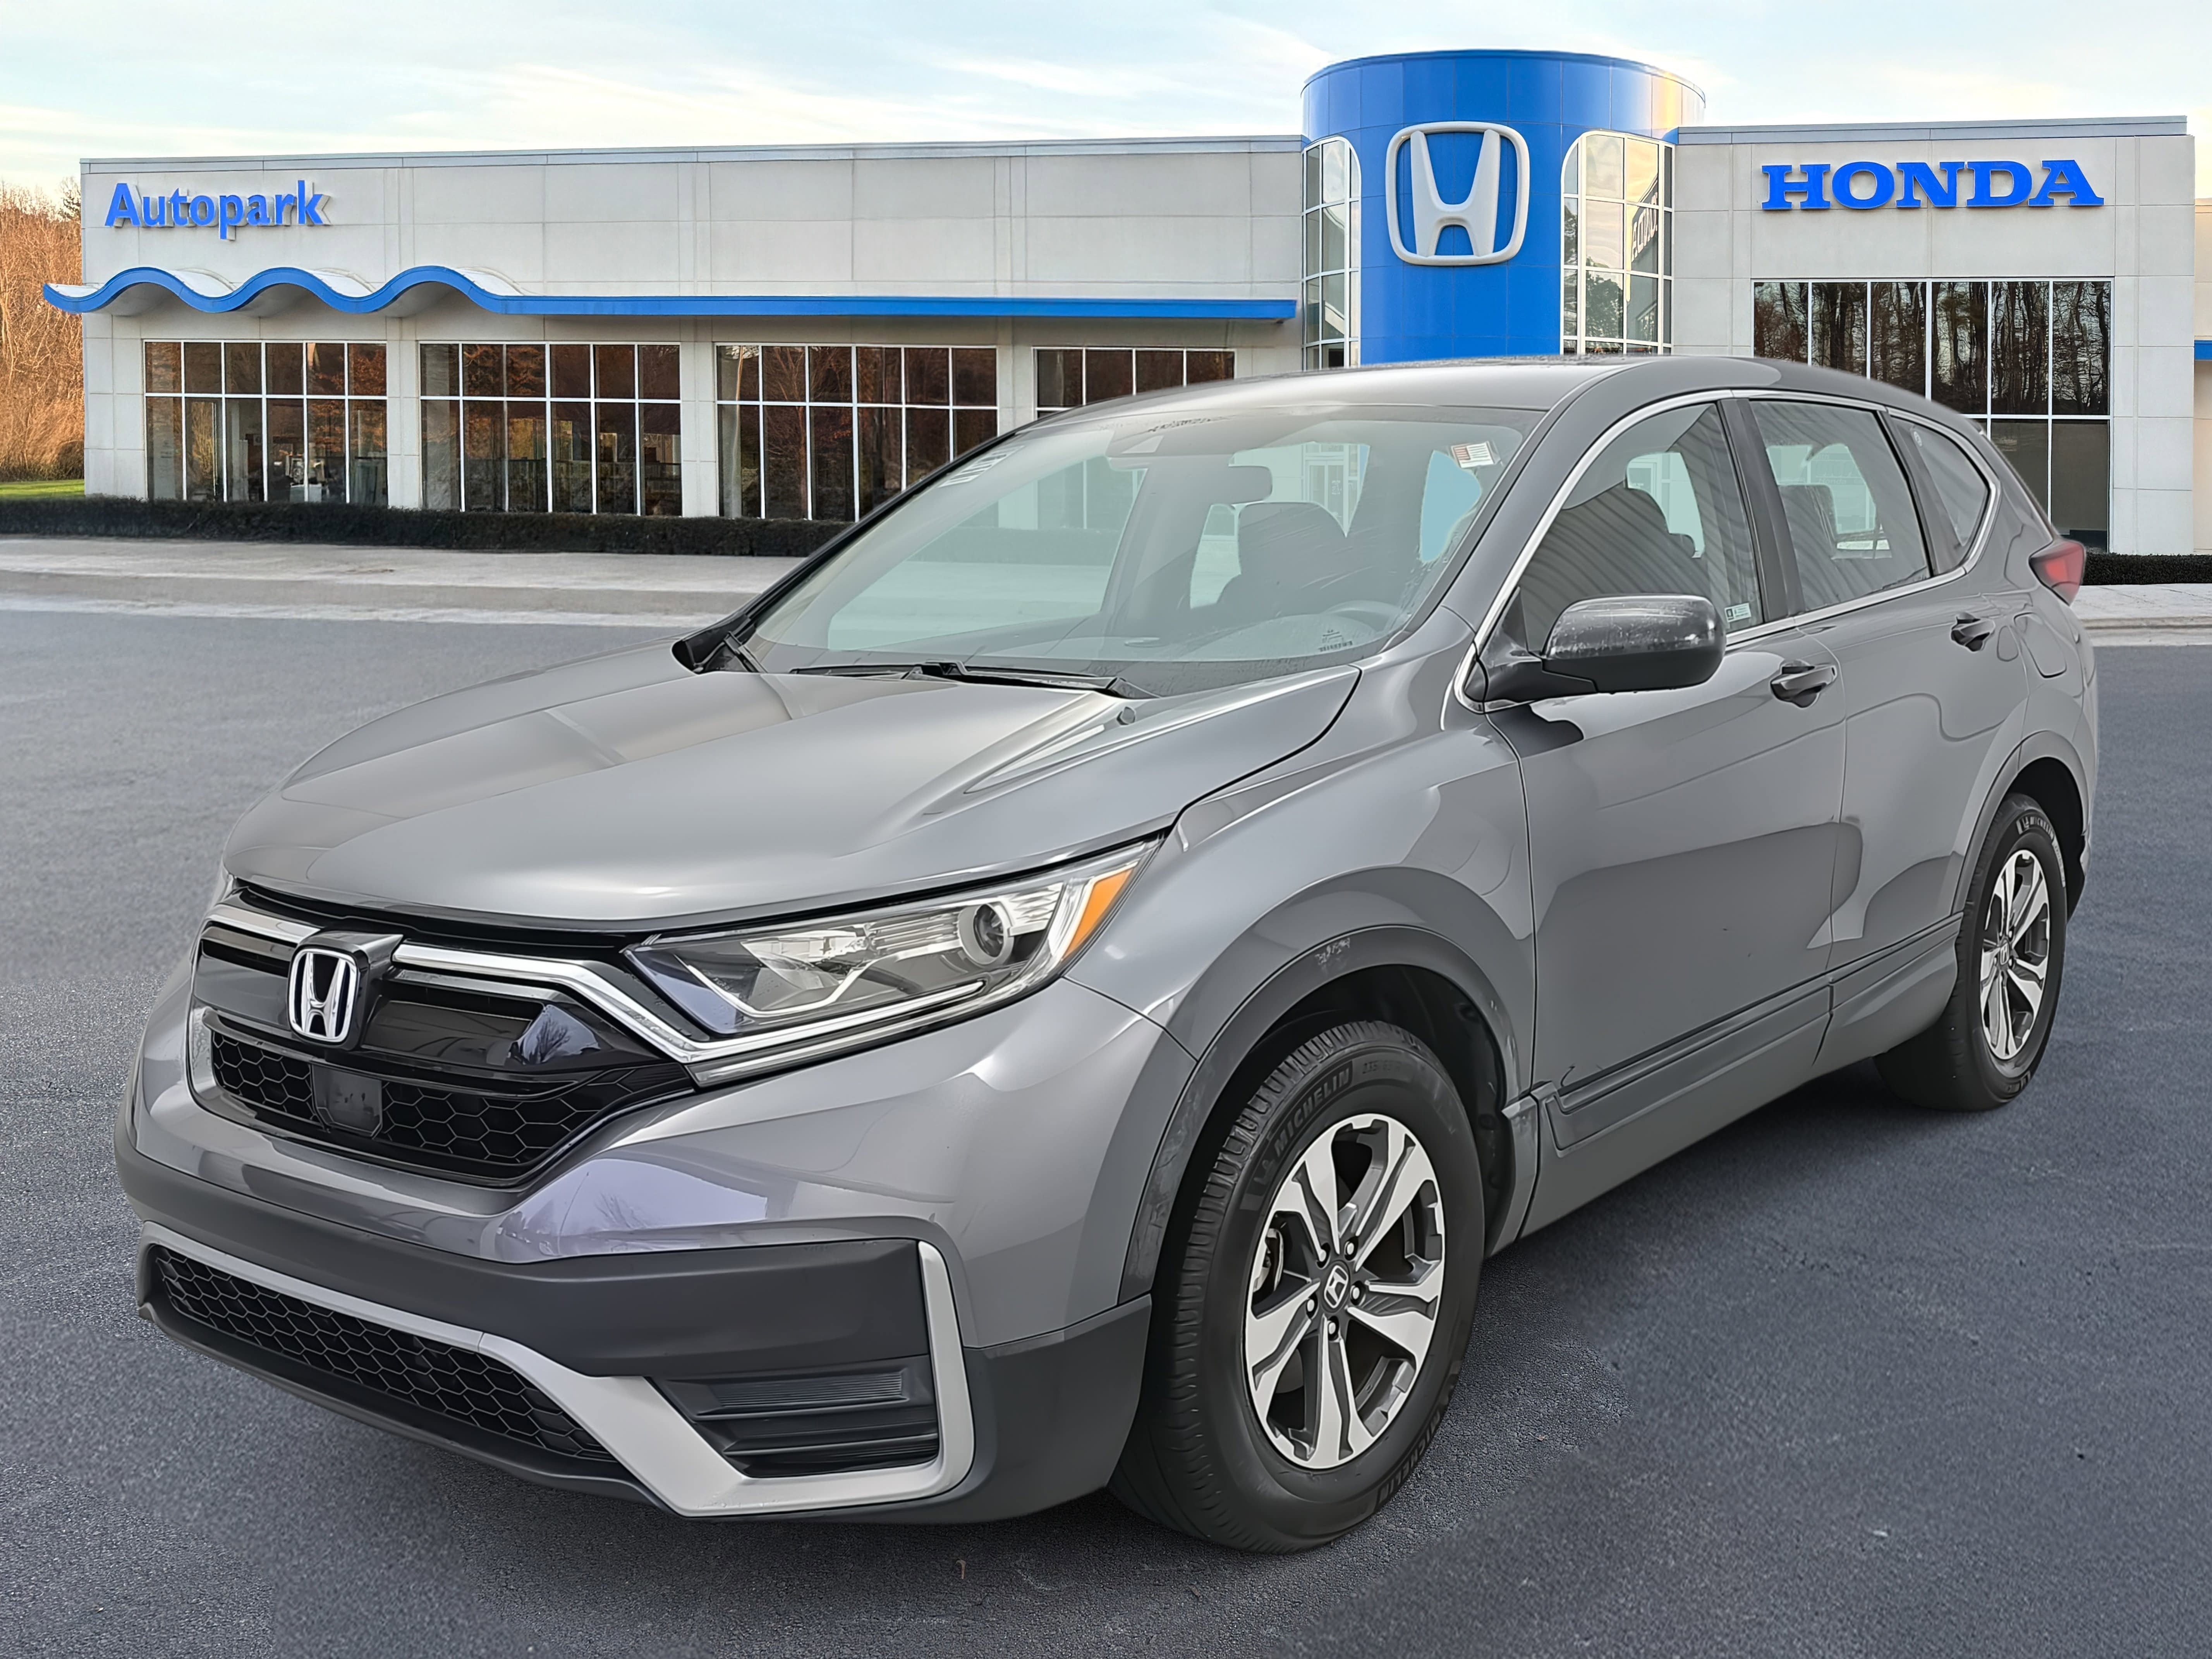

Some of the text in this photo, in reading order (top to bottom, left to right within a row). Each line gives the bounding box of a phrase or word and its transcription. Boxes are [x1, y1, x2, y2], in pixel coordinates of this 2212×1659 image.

[105, 180, 325, 240] Autopark
[1761, 160, 2104, 210] HONDA
[1274, 1068, 1350, 1156] MICHELIN
